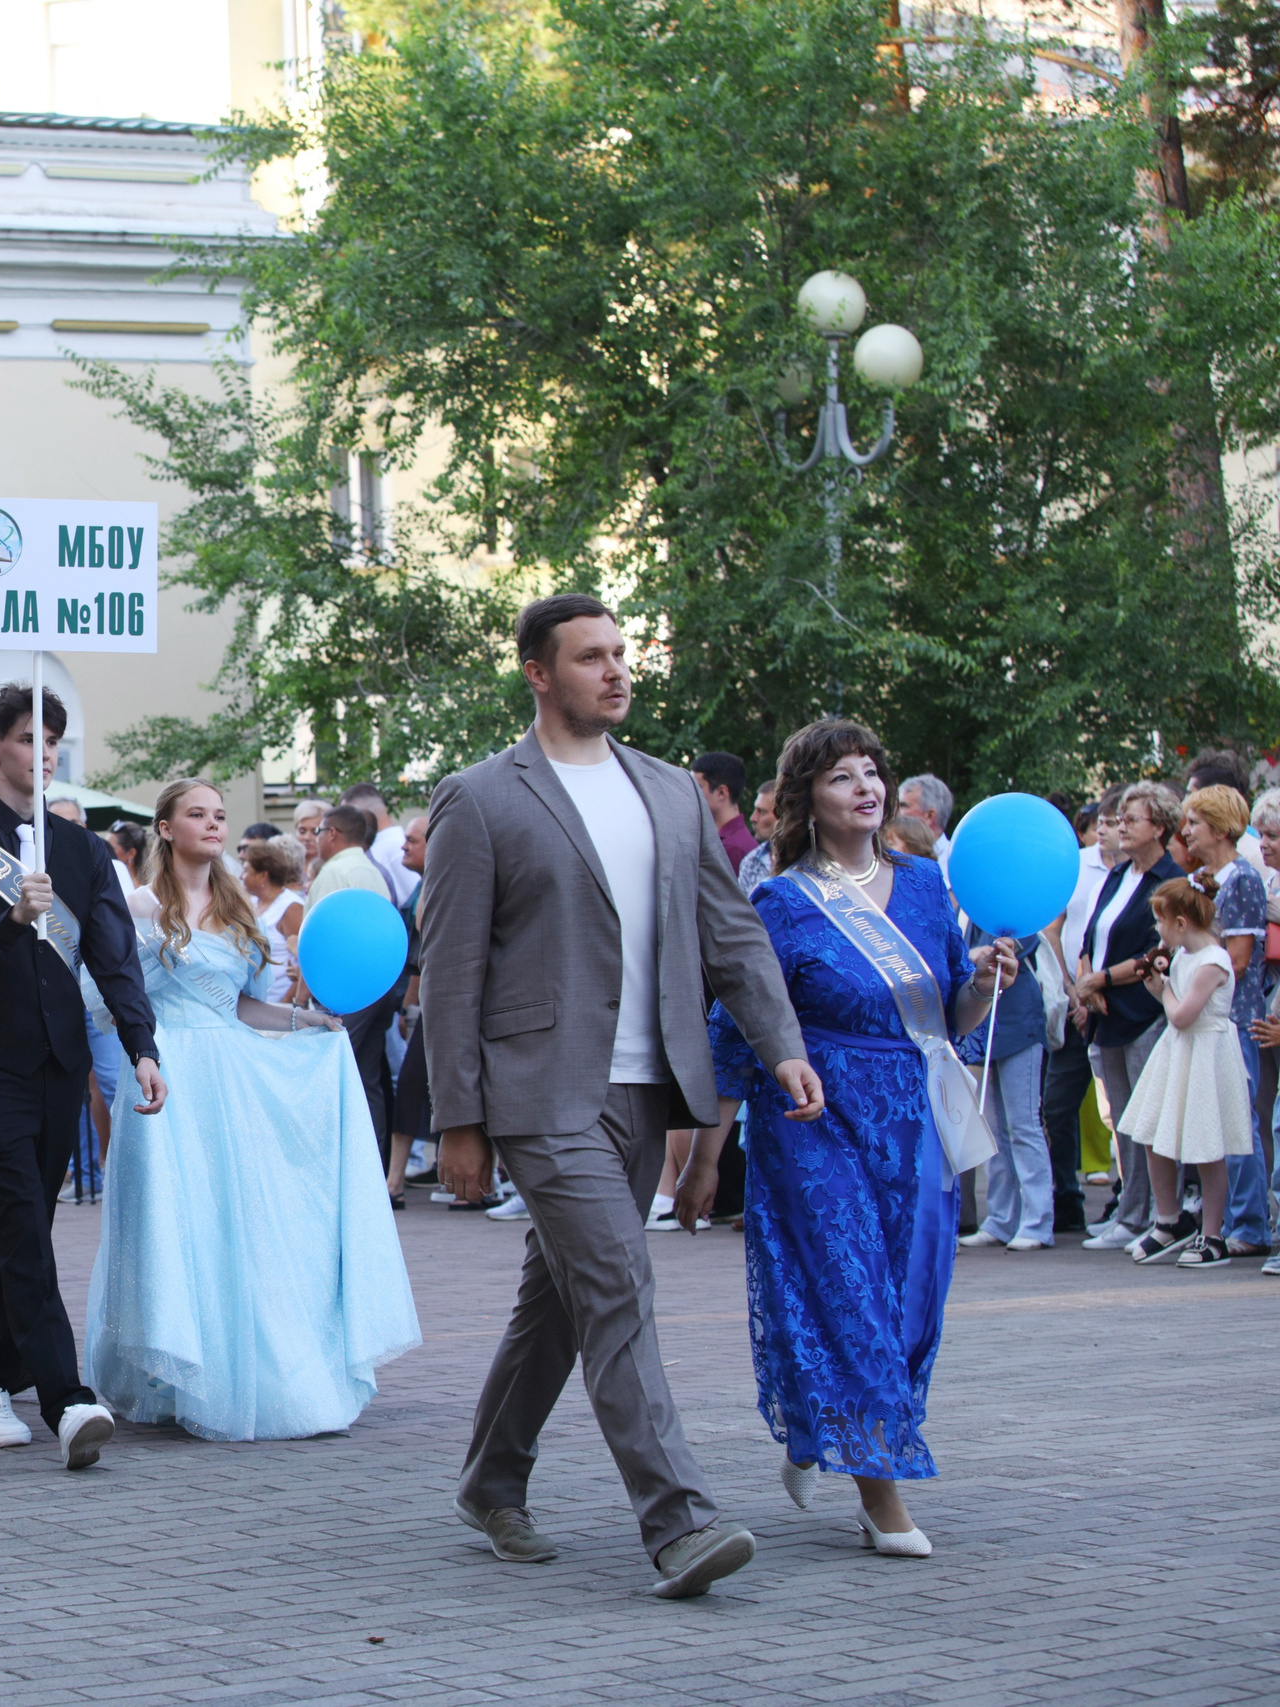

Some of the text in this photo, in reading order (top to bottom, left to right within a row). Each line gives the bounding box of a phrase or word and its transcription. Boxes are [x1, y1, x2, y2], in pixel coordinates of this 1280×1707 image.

[58, 524, 145, 570] МБОУ
[57, 591, 145, 637] №106
[835, 899, 898, 959] Классный
